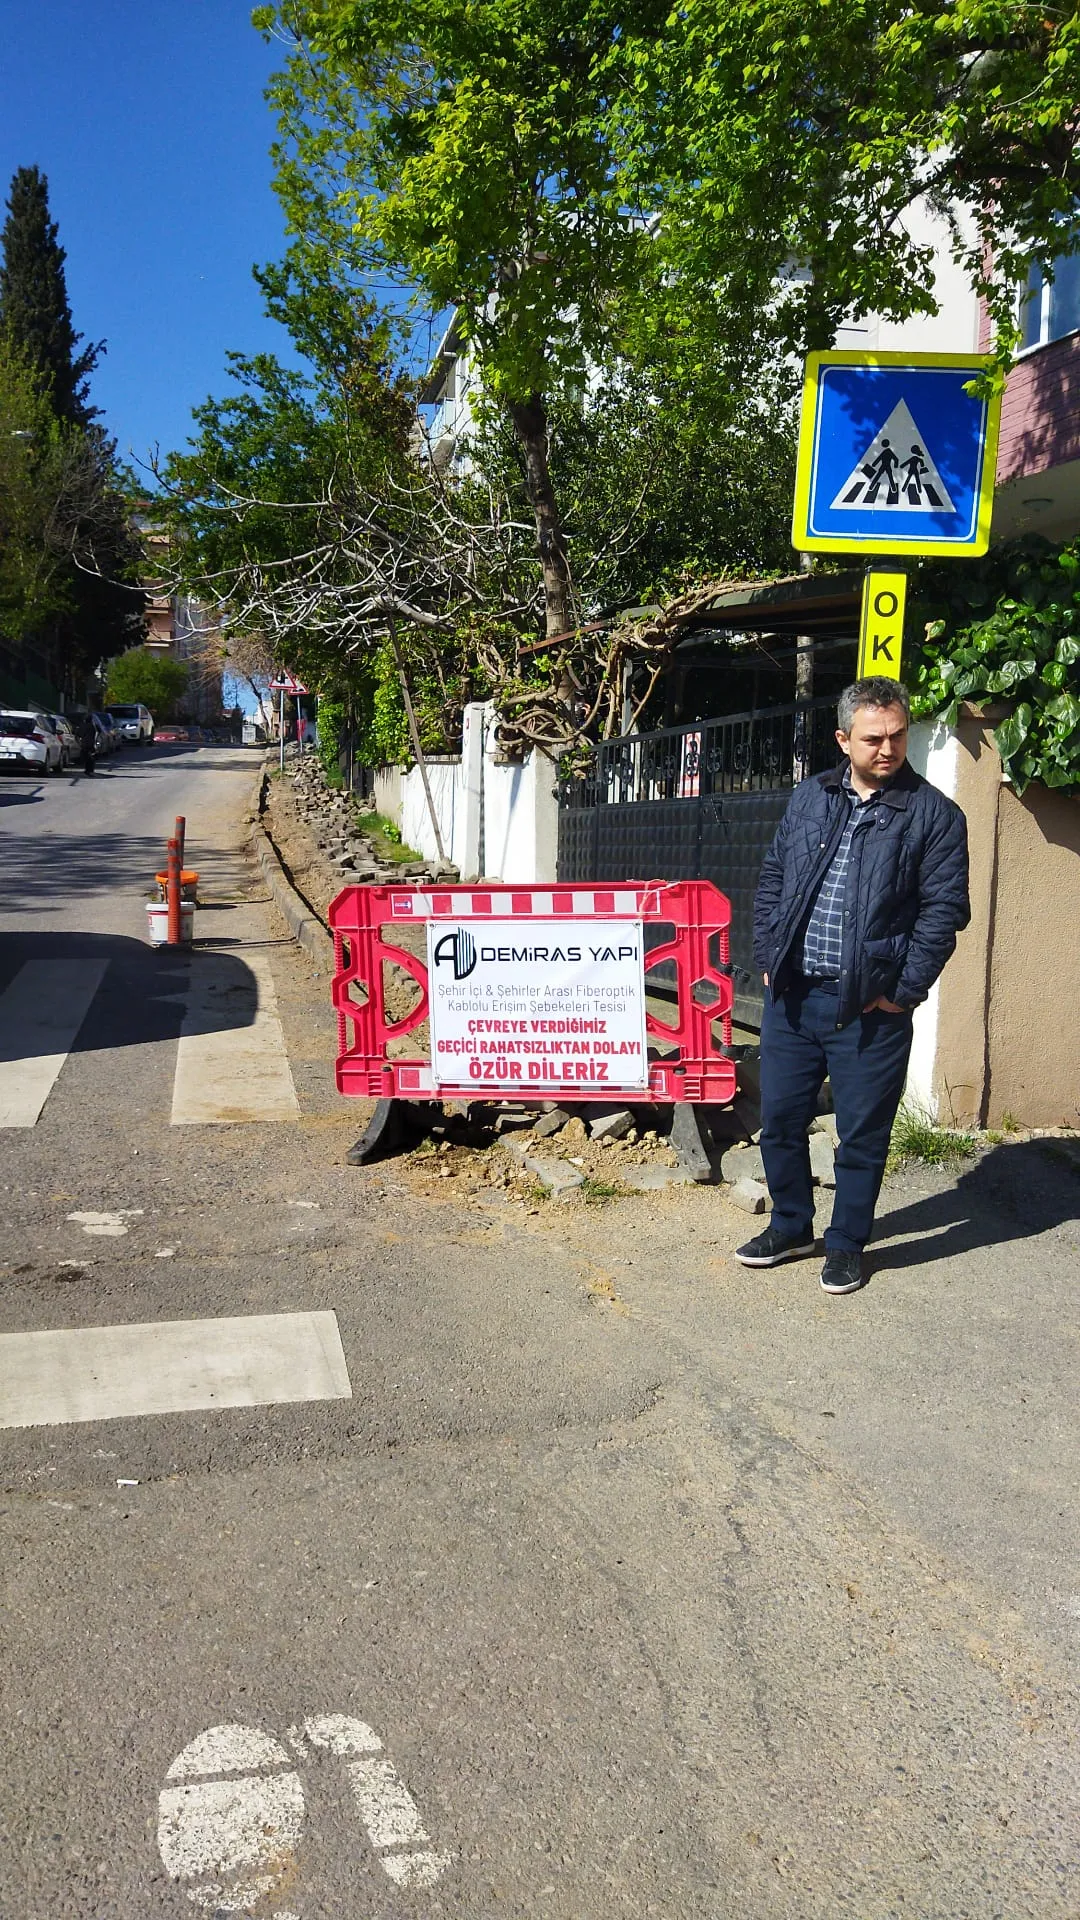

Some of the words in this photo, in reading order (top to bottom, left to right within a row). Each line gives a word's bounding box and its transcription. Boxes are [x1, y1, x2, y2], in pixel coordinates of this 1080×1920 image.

[588, 946, 638, 962] YAPI
[438, 984, 467, 998] Şehir
[469, 982, 482, 999] İçi
[485, 984, 494, 996] &
[497, 984, 541, 999] Şehirler
[544, 984, 573, 996] Arası
[576, 984, 636, 999] Fiberoptik
[448, 1000, 489, 1012] Kablolu
[492, 1000, 527, 1014] Erişim
[530, 1001, 590, 1014] Şebekeleri
[593, 1001, 626, 1012] Tesisi
[468, 1019, 528, 1035] ÇEVREYE
[530, 1017, 607, 1033] VERDİĞİMİZ
[437, 1036, 477, 1056] GEÇİCİ
[480, 1040, 590, 1054] RAHATSIZLIKTAN
[593, 1041, 640, 1055] DOLAYI
[469, 1056, 523, 1080] ÖZÜR
[528, 1057, 609, 1080] DİLERİZ
